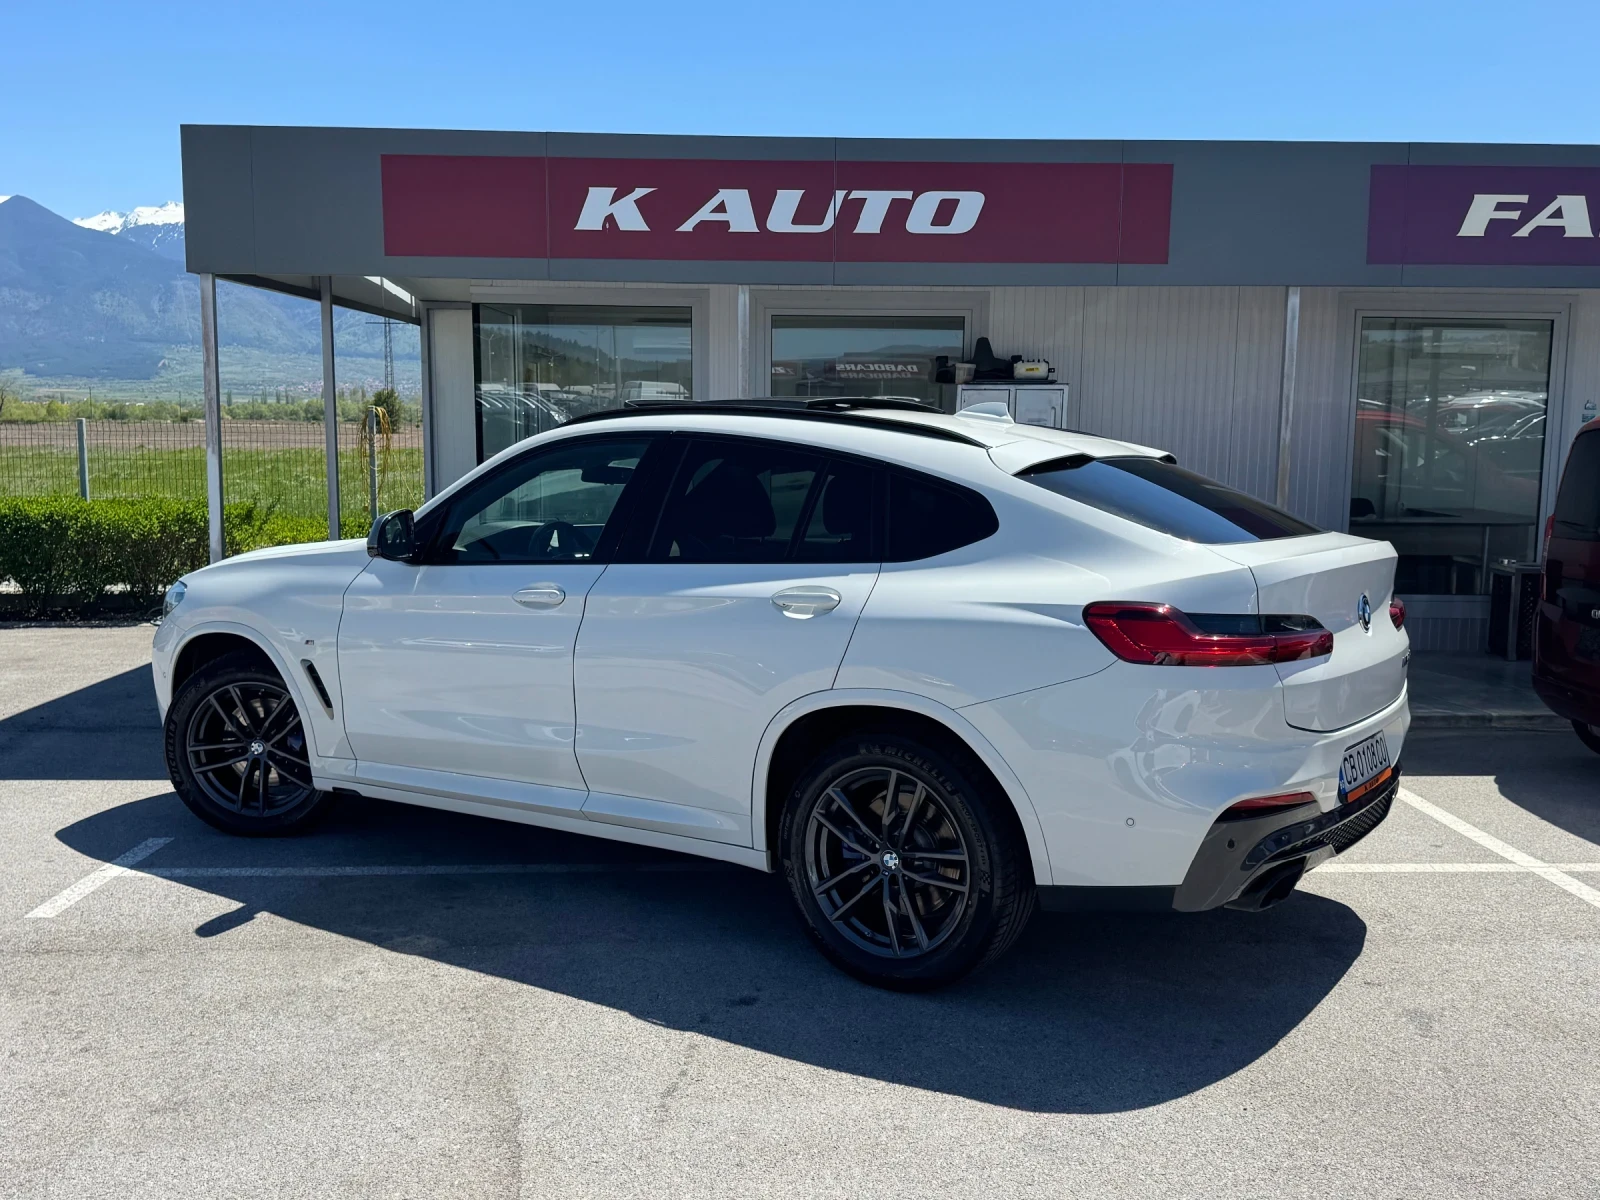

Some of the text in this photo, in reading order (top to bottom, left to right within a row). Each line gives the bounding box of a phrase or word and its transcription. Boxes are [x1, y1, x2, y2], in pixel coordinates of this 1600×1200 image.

[574, 187, 986, 235] K AUTO
[1456, 194, 1600, 238] FA
[884, 745, 957, 796] MICHELIN
[1343, 754, 1358, 786] CB
[1356, 743, 1378, 777] 0108
[970, 823, 984, 849] SPORT
